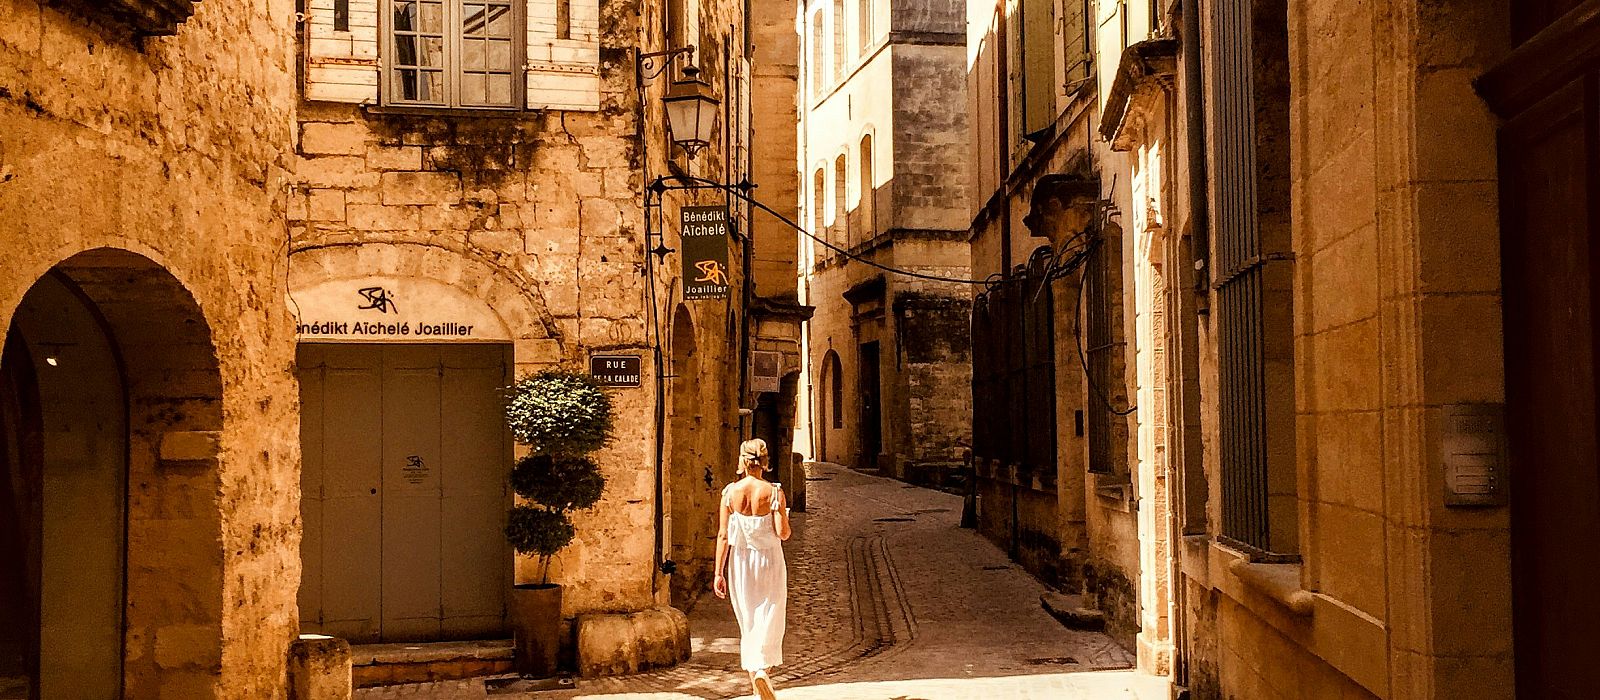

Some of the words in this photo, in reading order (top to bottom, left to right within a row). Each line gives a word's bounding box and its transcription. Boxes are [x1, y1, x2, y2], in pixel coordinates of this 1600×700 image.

[683, 211, 725, 222] Bénédikt
[682, 223, 726, 237] Aïchelé
[685, 285, 727, 294] Joaillier
[352, 321, 410, 335] Aïchelé
[414, 322, 474, 336] Joaillier
[606, 360, 626, 369] RUE
[614, 374, 639, 383] CALADE
